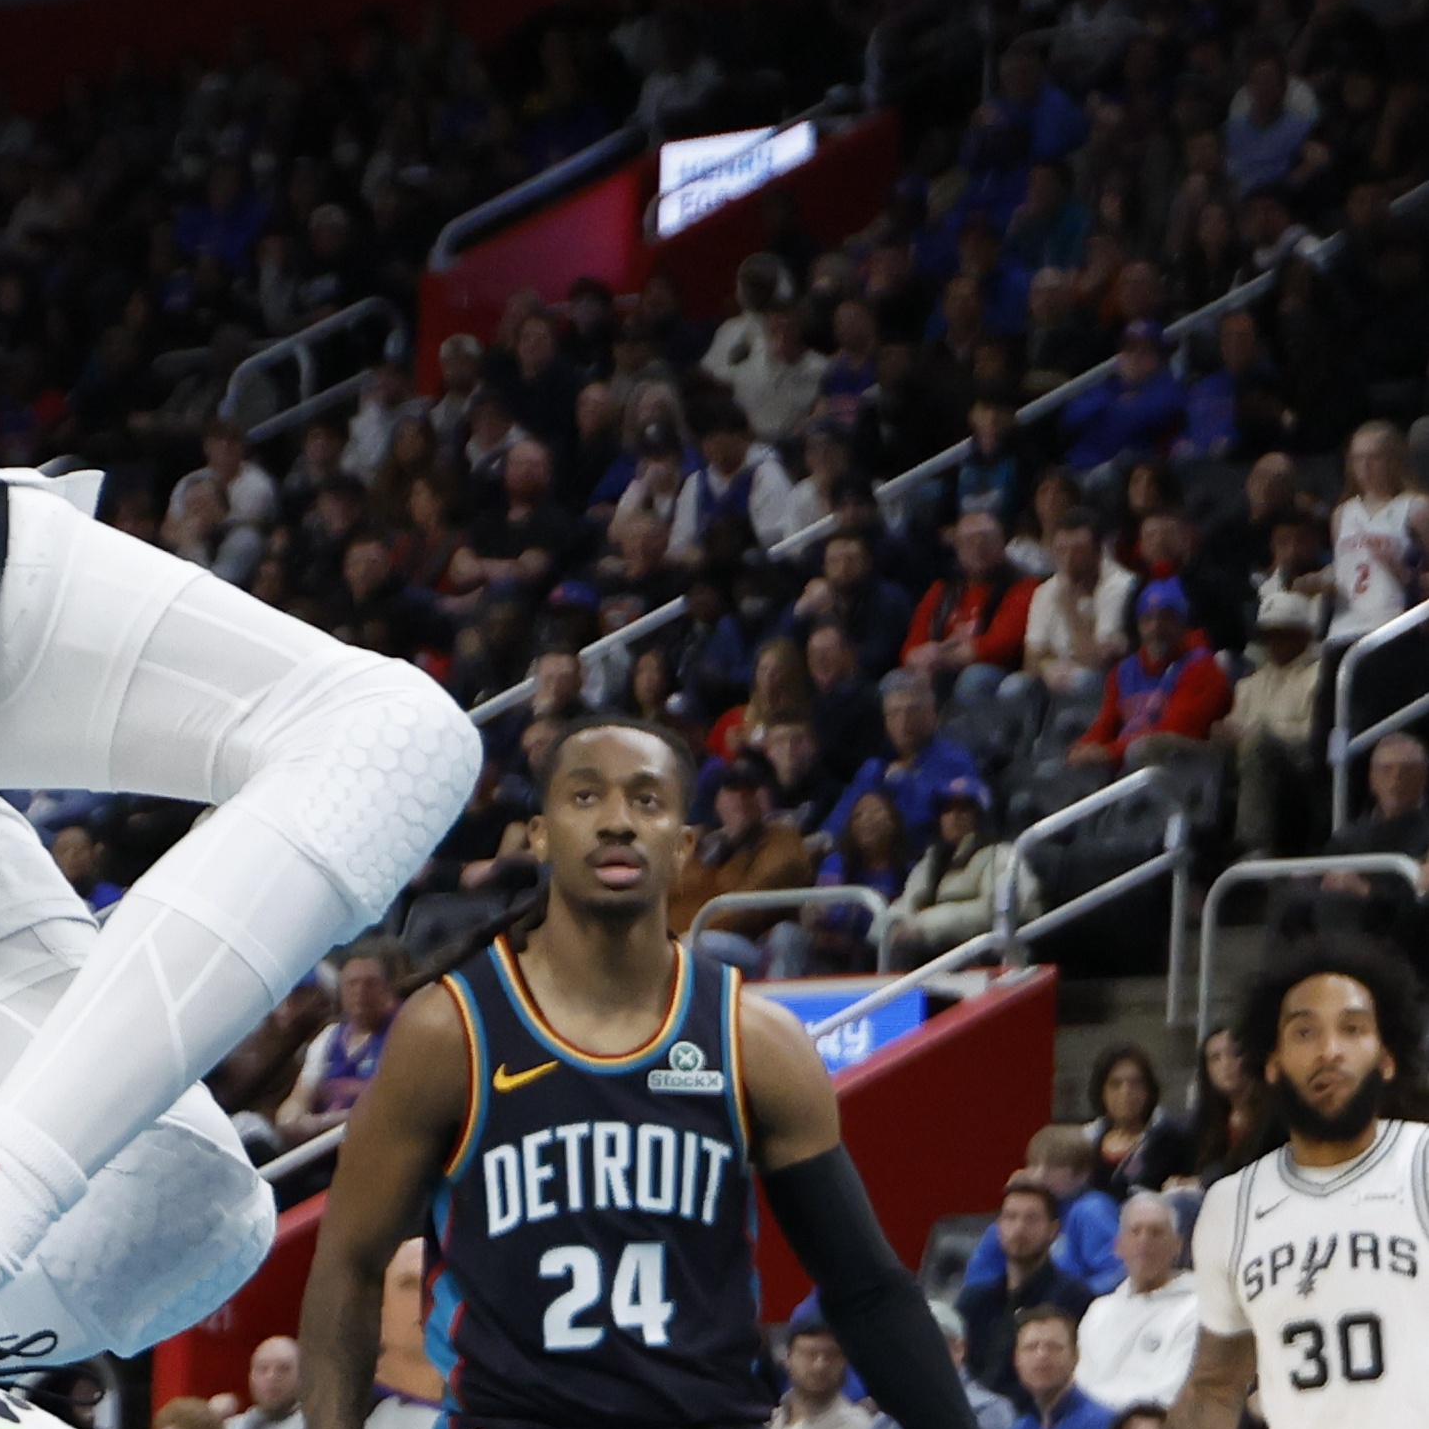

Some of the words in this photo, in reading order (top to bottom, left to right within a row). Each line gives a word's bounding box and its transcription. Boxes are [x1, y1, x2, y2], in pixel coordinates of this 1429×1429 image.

[651, 1072, 719, 1088] StockX
[483, 1121, 733, 1238] DETROIT
[538, 1242, 674, 1351] 24
[1242, 1231, 1418, 1303] SPURS
[1282, 1311, 1385, 1391] 30
